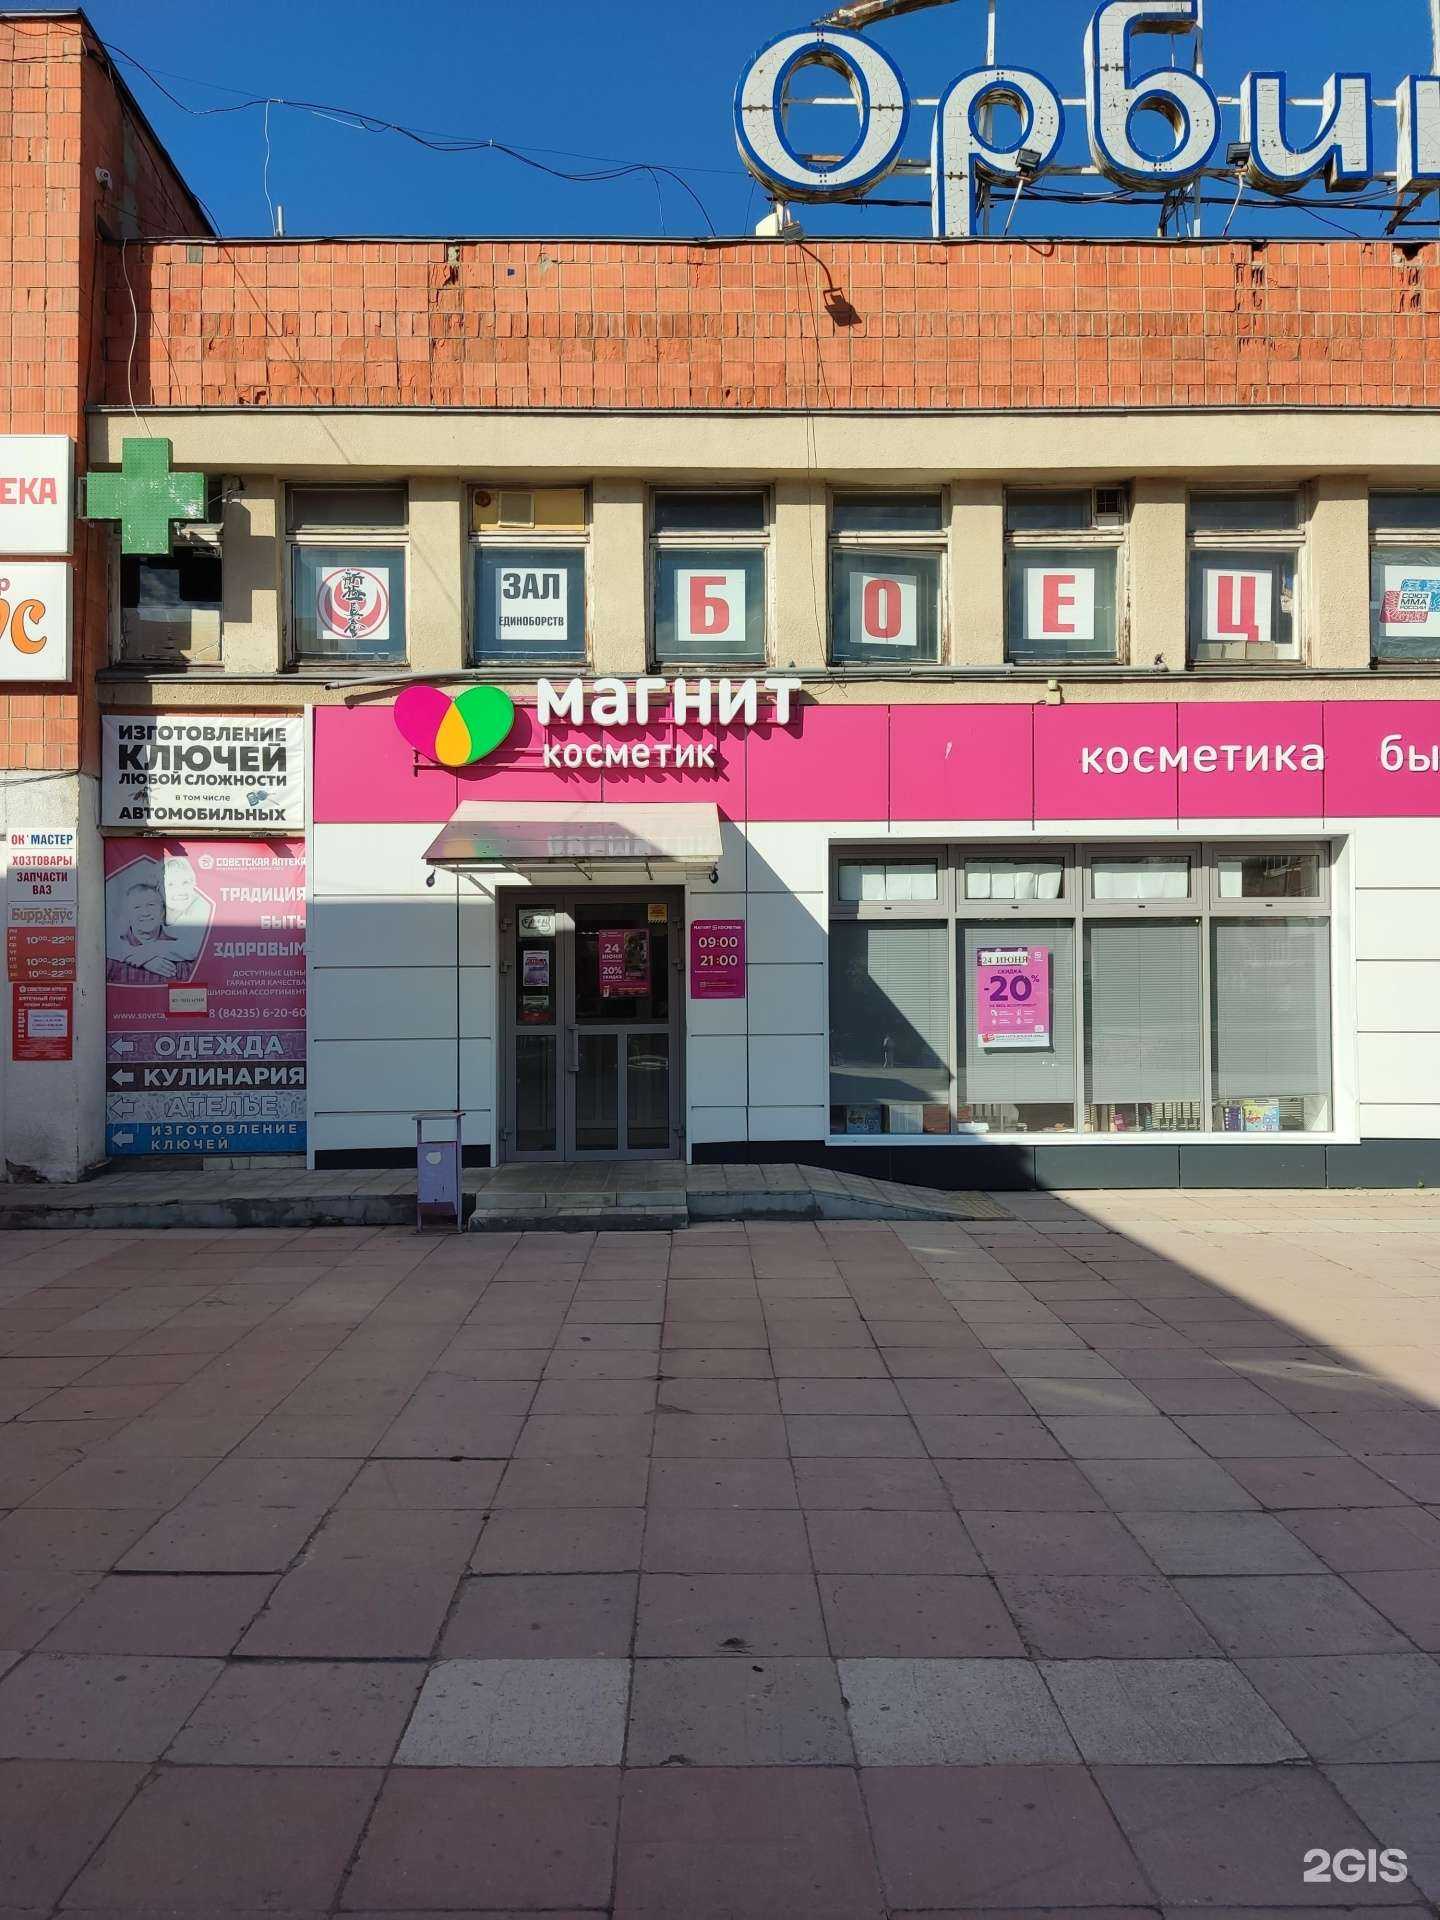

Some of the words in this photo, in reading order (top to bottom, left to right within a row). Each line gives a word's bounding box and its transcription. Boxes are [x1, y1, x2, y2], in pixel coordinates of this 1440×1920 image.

[734, 0, 1440, 238] Орби
[502, 572, 560, 599] ЗАЛ
[690, 576, 729, 634] Б
[864, 579, 901, 638] О
[1043, 575, 1075, 633] Е
[1217, 575, 1259, 642] Ц
[499, 616, 564, 627] ЕДИНОБОРСТВ
[118, 725, 287, 742] ИЗГОТОВЛЕНИЕ
[118, 743, 287, 772] КЛЮЧЕЙ
[543, 742, 716, 769] косметик
[1081, 743, 1326, 775] косметика
[118, 771, 182, 785] ЛЮБОЙ
[184, 773, 287, 787] СЛОЖНОСТИ
[202, 794, 231, 802] числе
[119, 806, 286, 821] АВТОМОБИЛЬНЫХ
[31, 834, 73, 845] МАСТЕР
[12, 855, 72, 866] ХОЗТОВАРЫ
[216, 857, 270, 867] СОВЕТСКАЯ
[16, 872, 68, 882] ЗАПЧАСТИ
[32, 885, 52, 895] ВАЗ
[220, 887, 306, 902] ТРАДИЦИЯ
[259, 915, 306, 929] БЫТЬ
[604, 943, 620, 953] 24
[698, 937, 738, 948] 09:00
[213, 942, 306, 958] ЗДОРОВЫМ
[700, 955, 738, 966] 21:00
[996, 955, 1028, 964] ИЮНЯ
[232, 969, 281, 978] ДОСТУПНЫЕ
[602, 966, 623, 975] 20%
[249, 988, 305, 996] АССОРТИМЕНТ
[208, 1008, 216, 1018] 8
[218, 1007, 260, 1019] (84235)
[262, 1008, 306, 1018] 6-20-60
[154, 1035, 284, 1059] ОДЕЖДА
[143, 1067, 305, 1087] КУЛИНАРИЯ
[166, 1095, 279, 1117] АТЕЛЬЕ
[151, 1125, 297, 1135] ИЗГОТОВЛЕНИЕ
[151, 1137, 229, 1150] КЛЮЧЕЙ
